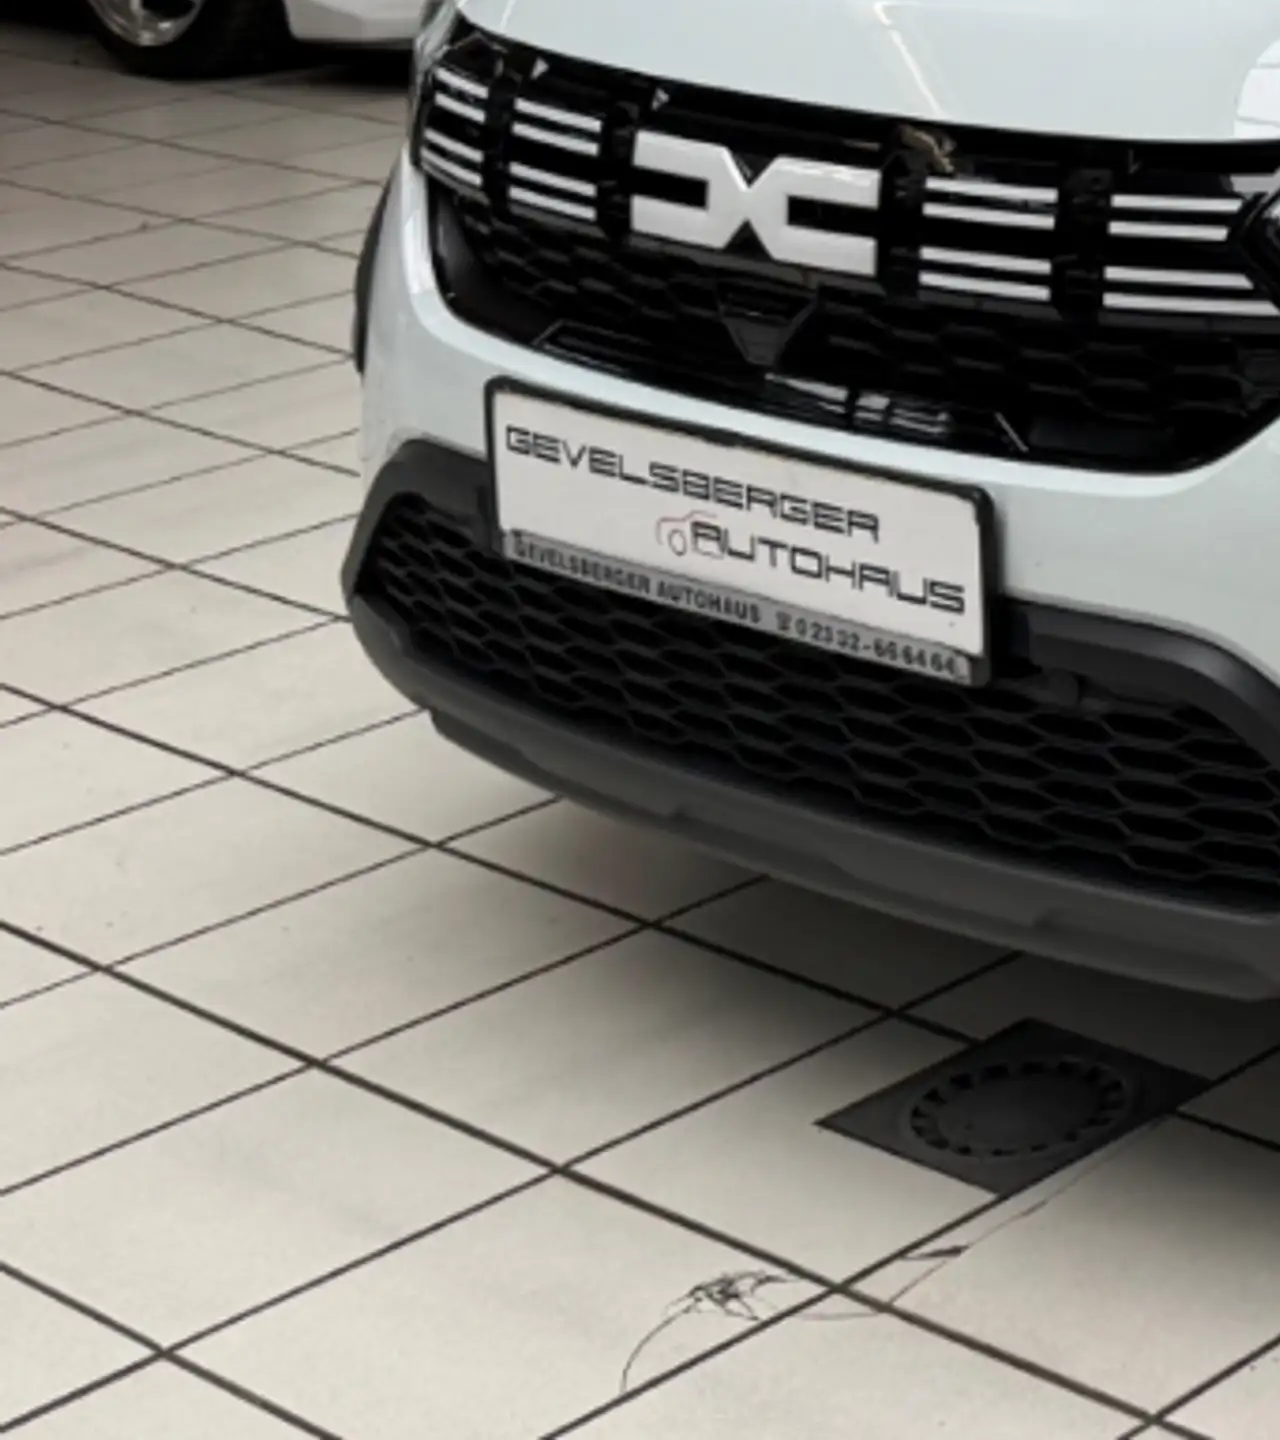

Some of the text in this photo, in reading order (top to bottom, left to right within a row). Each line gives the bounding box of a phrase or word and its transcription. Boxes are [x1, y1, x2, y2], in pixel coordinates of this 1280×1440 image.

[505, 424, 880, 543] GEVELSBERGER
[656, 580, 762, 625] AUTOHAUS
[691, 520, 966, 615] AUTOHAUS
